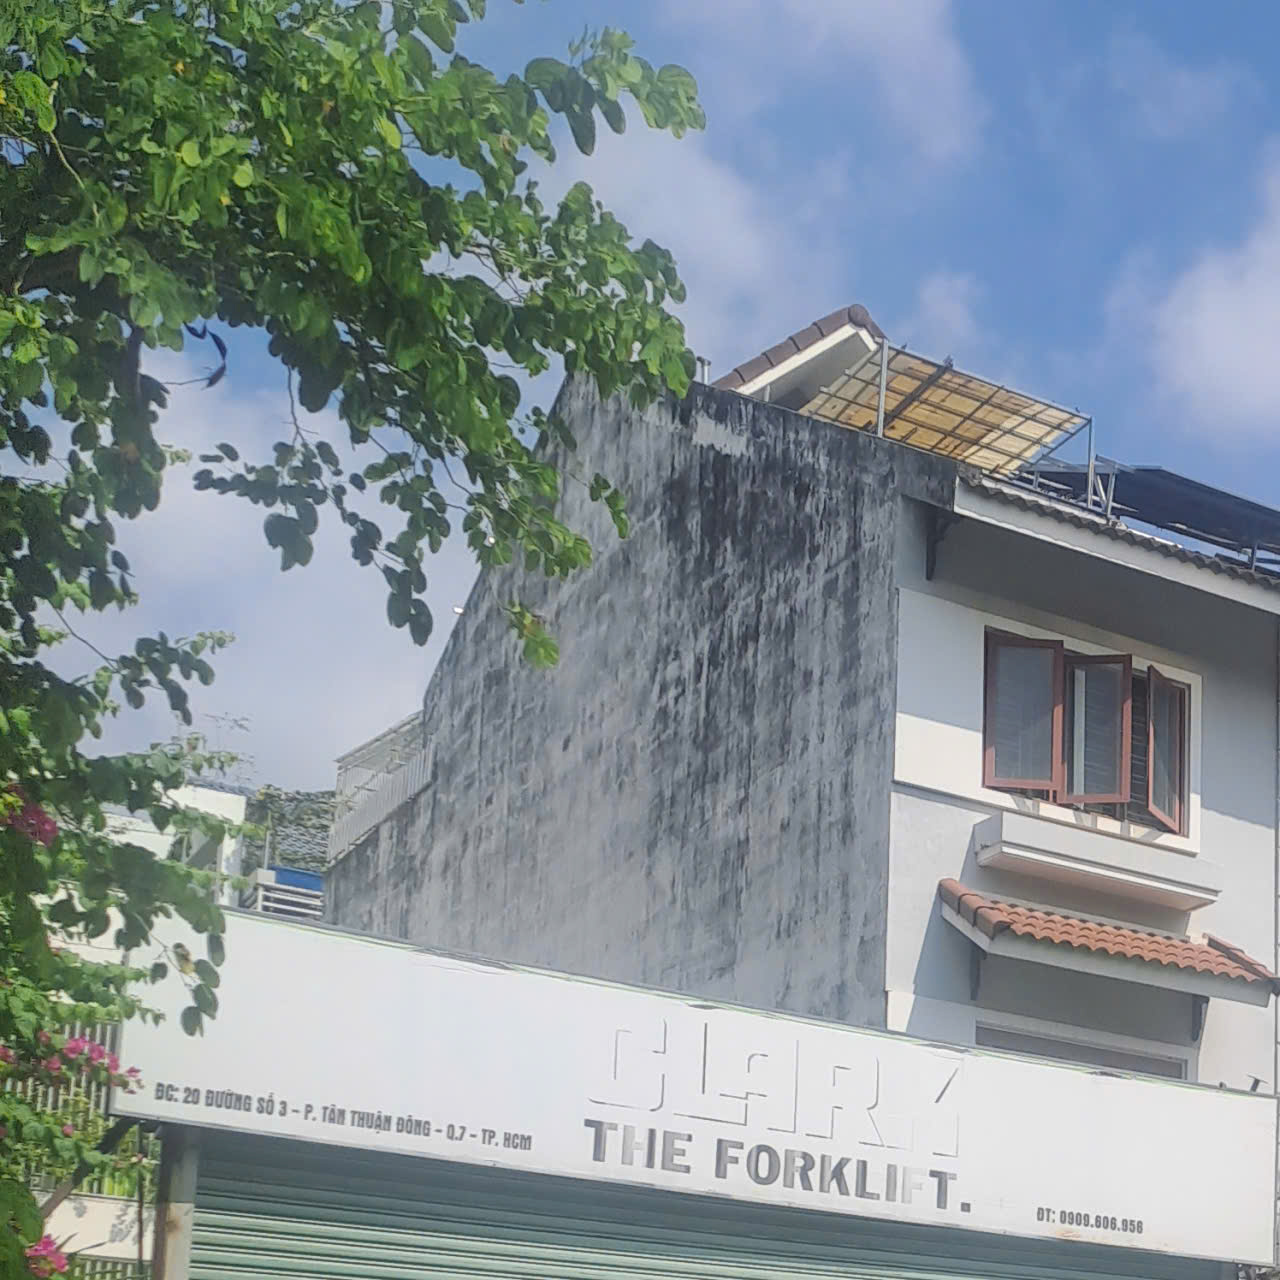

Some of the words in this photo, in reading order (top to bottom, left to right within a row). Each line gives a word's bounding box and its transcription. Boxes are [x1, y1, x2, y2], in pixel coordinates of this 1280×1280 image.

[154, 1082, 178, 1102] ĐC:
[182, 1086, 200, 1104] 20
[205, 1088, 252, 1112] ĐƯỜNG
[256, 1092, 274, 1115] SỐ
[279, 1100, 287, 1117] 3
[304, 1103, 317, 1122] P.
[322, 1104, 346, 1126] TÂN
[350, 1110, 392, 1134] THUẬN
[396, 1115, 431, 1137] ĐÔNG
[446, 1123, 466, 1142] Q.7
[481, 1128, 498, 1147] TP.
[503, 1131, 532, 1151] HCM
[584, 1118, 693, 1174] THE
[715, 1137, 971, 1213] FORKLIFT.
